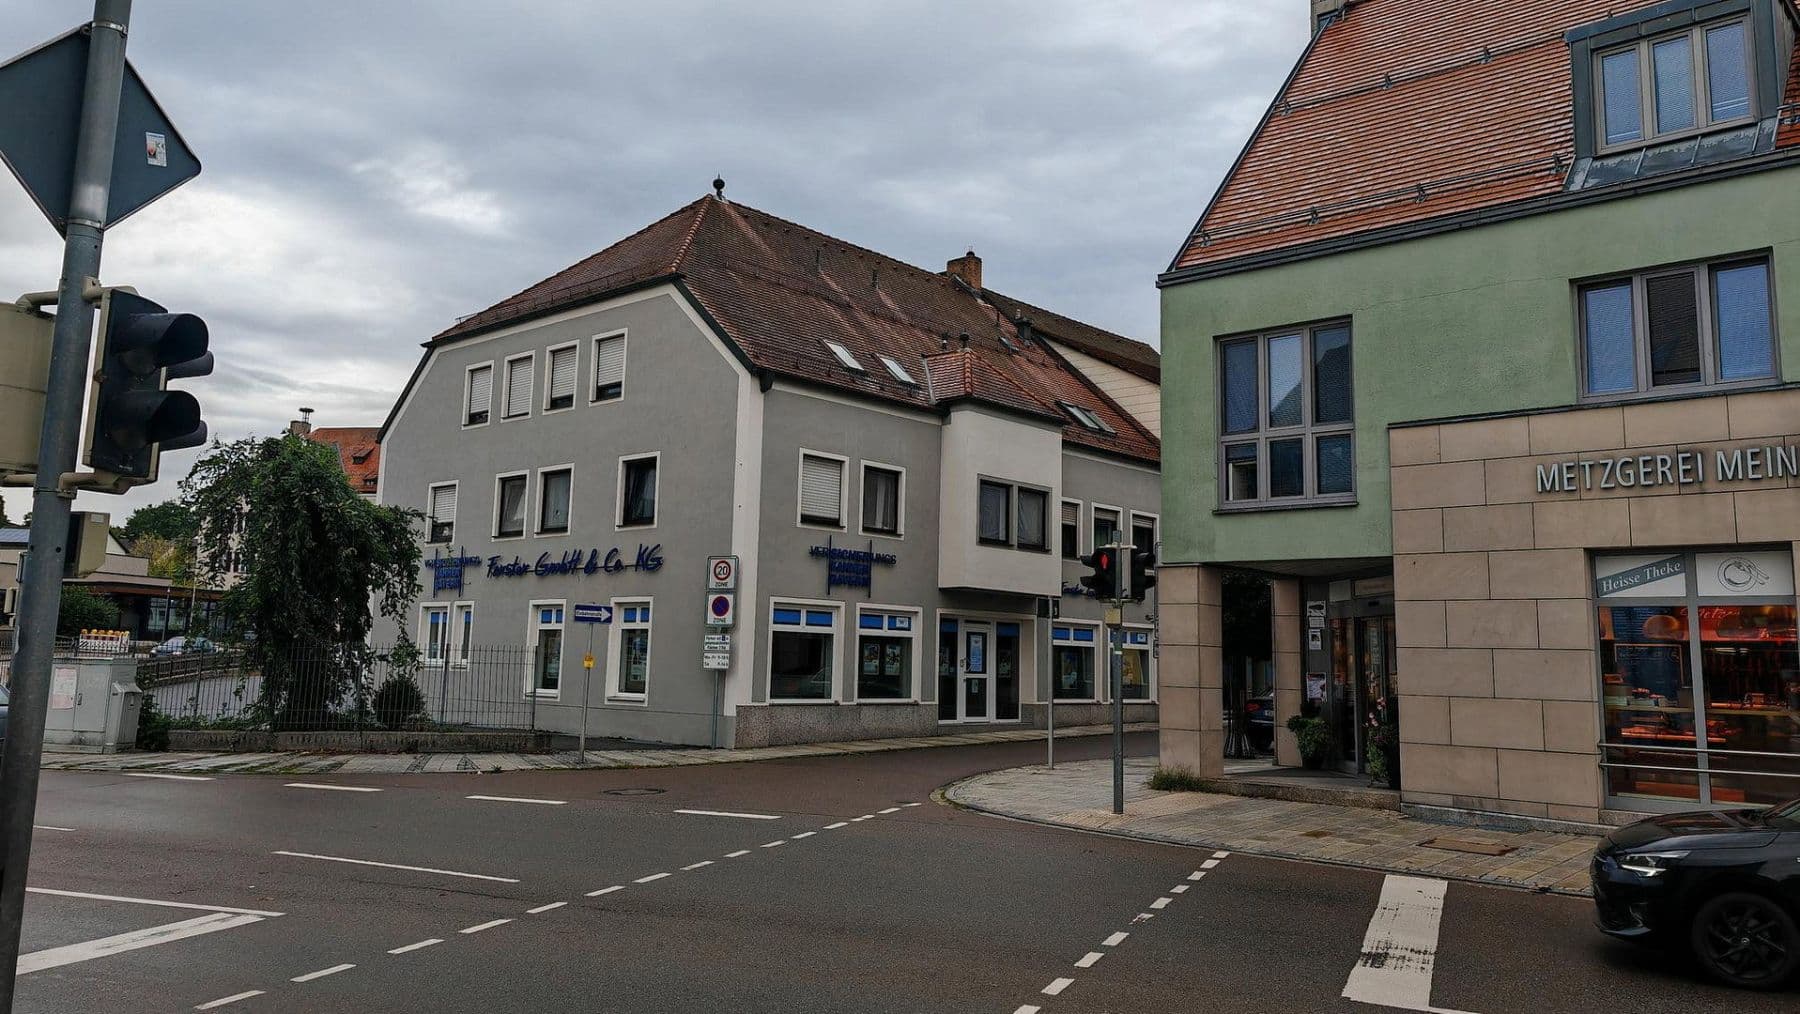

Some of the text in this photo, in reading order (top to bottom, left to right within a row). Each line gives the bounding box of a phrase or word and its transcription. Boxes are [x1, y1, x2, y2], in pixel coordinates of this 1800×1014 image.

[1536, 445, 1798, 493] METZGEREI MEIN
[535, 550, 582, 575] GmbH
[635, 543, 664, 572] KG
[717, 565, 728, 576] 20
[1602, 560, 1681, 593] Heisse Theke
